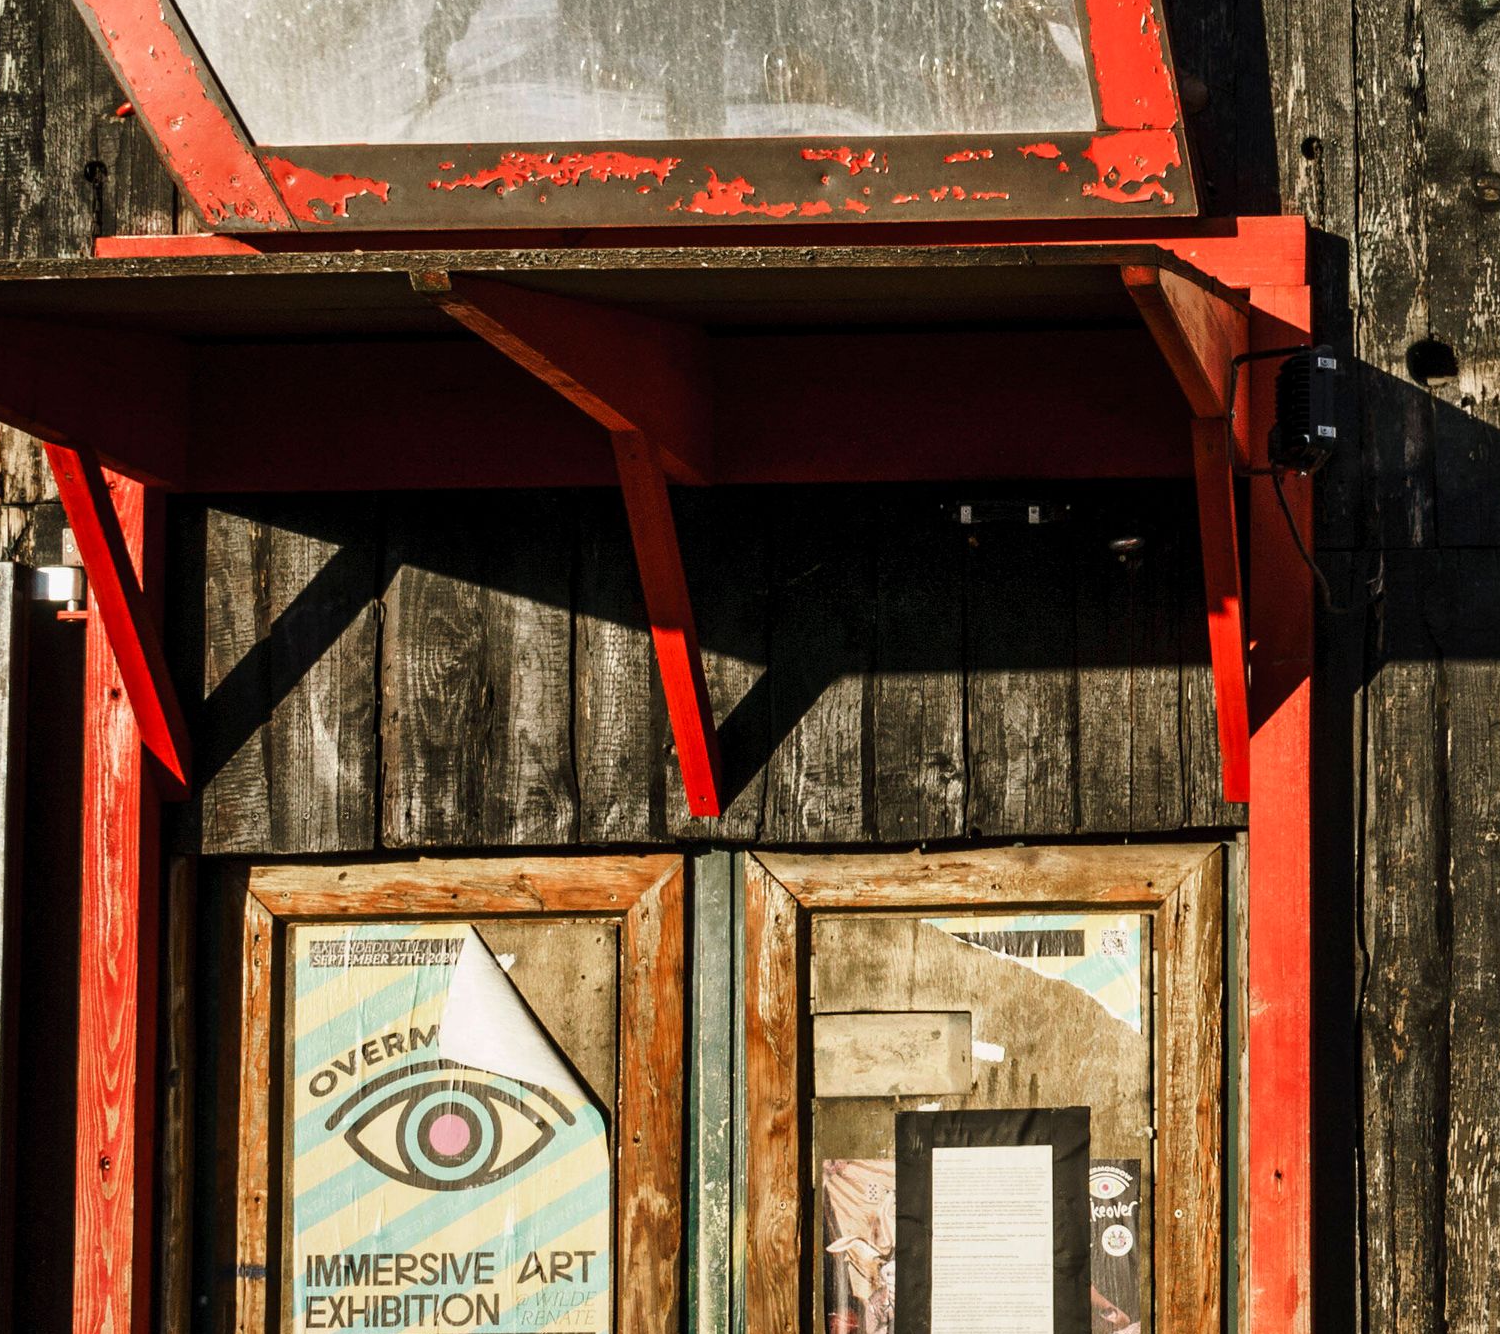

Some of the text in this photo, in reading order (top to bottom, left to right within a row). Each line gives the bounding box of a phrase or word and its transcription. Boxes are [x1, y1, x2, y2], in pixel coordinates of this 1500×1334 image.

[311, 941, 382, 954] EXTENDED
[312, 953, 388, 966] SEPTEMBER
[391, 952, 425, 965] 27TH
[309, 1024, 440, 1098] OVERM
[306, 1250, 596, 1287] IMMERSIVE ART
[532, 1290, 597, 1307] WILDE
[306, 1292, 500, 1328] EXHIBITION
[520, 1309, 596, 1326] RENATE
